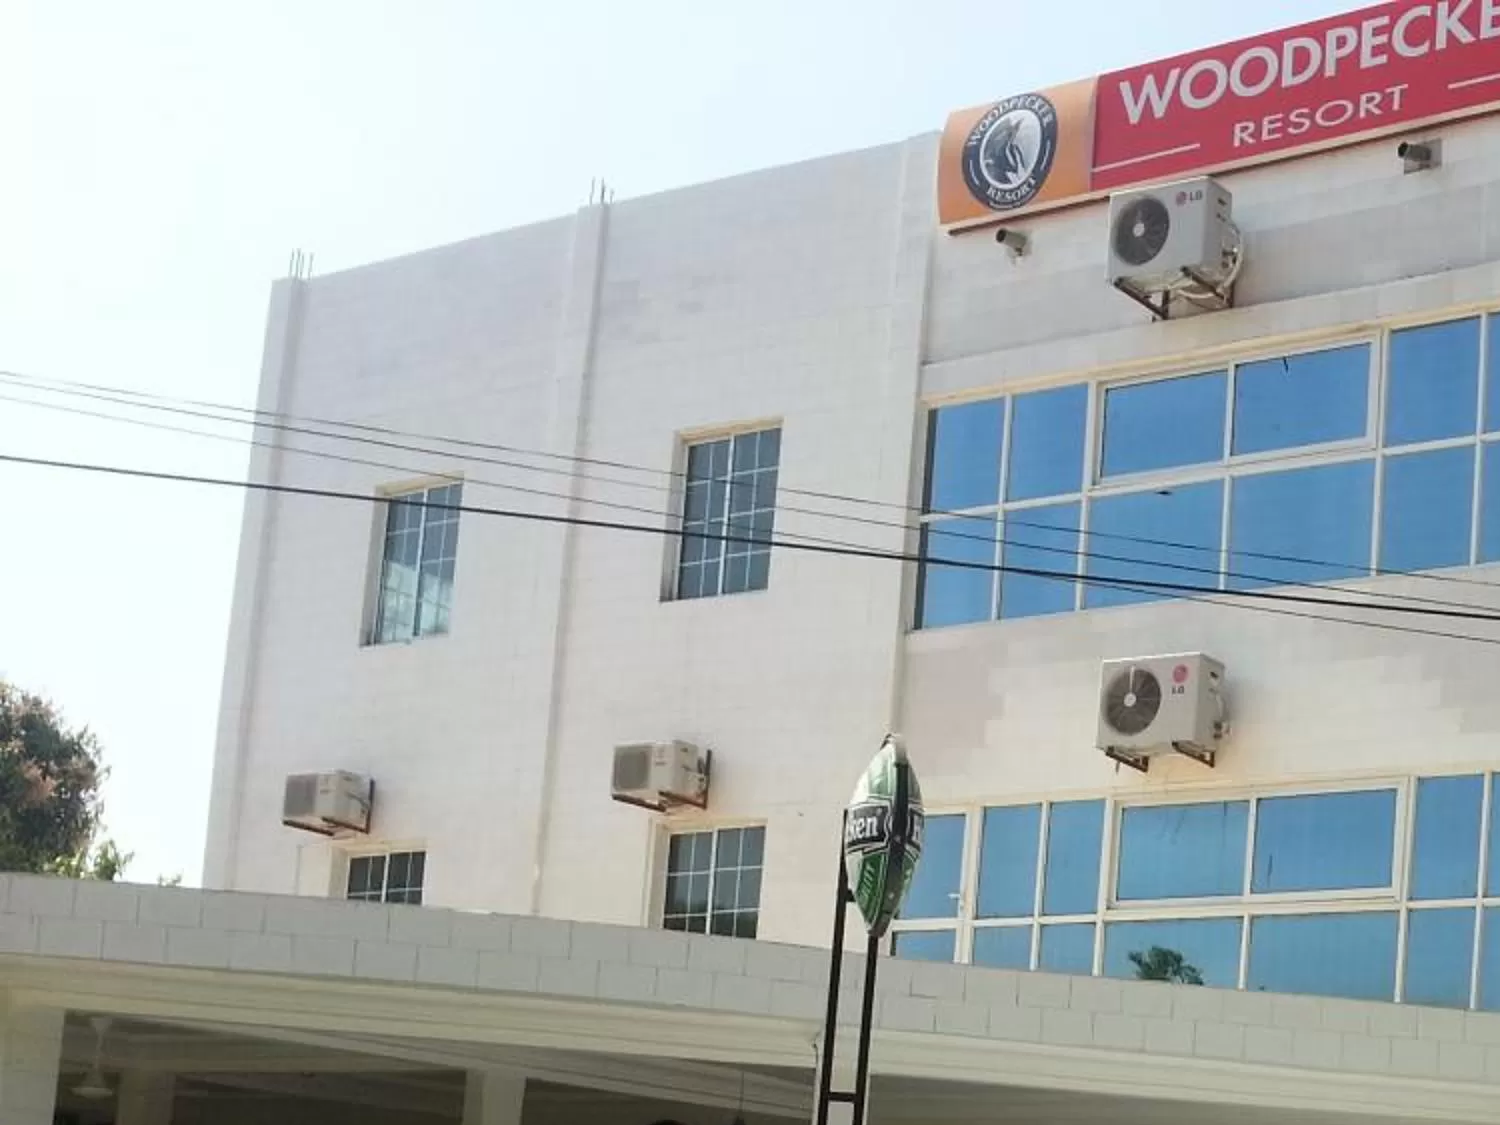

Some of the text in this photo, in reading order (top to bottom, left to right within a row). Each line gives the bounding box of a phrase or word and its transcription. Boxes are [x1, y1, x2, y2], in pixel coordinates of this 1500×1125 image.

[967, 95, 1055, 147] WOODPECKER
[1233, 84, 1409, 147] RESORT
[987, 177, 1036, 201] RESORT
